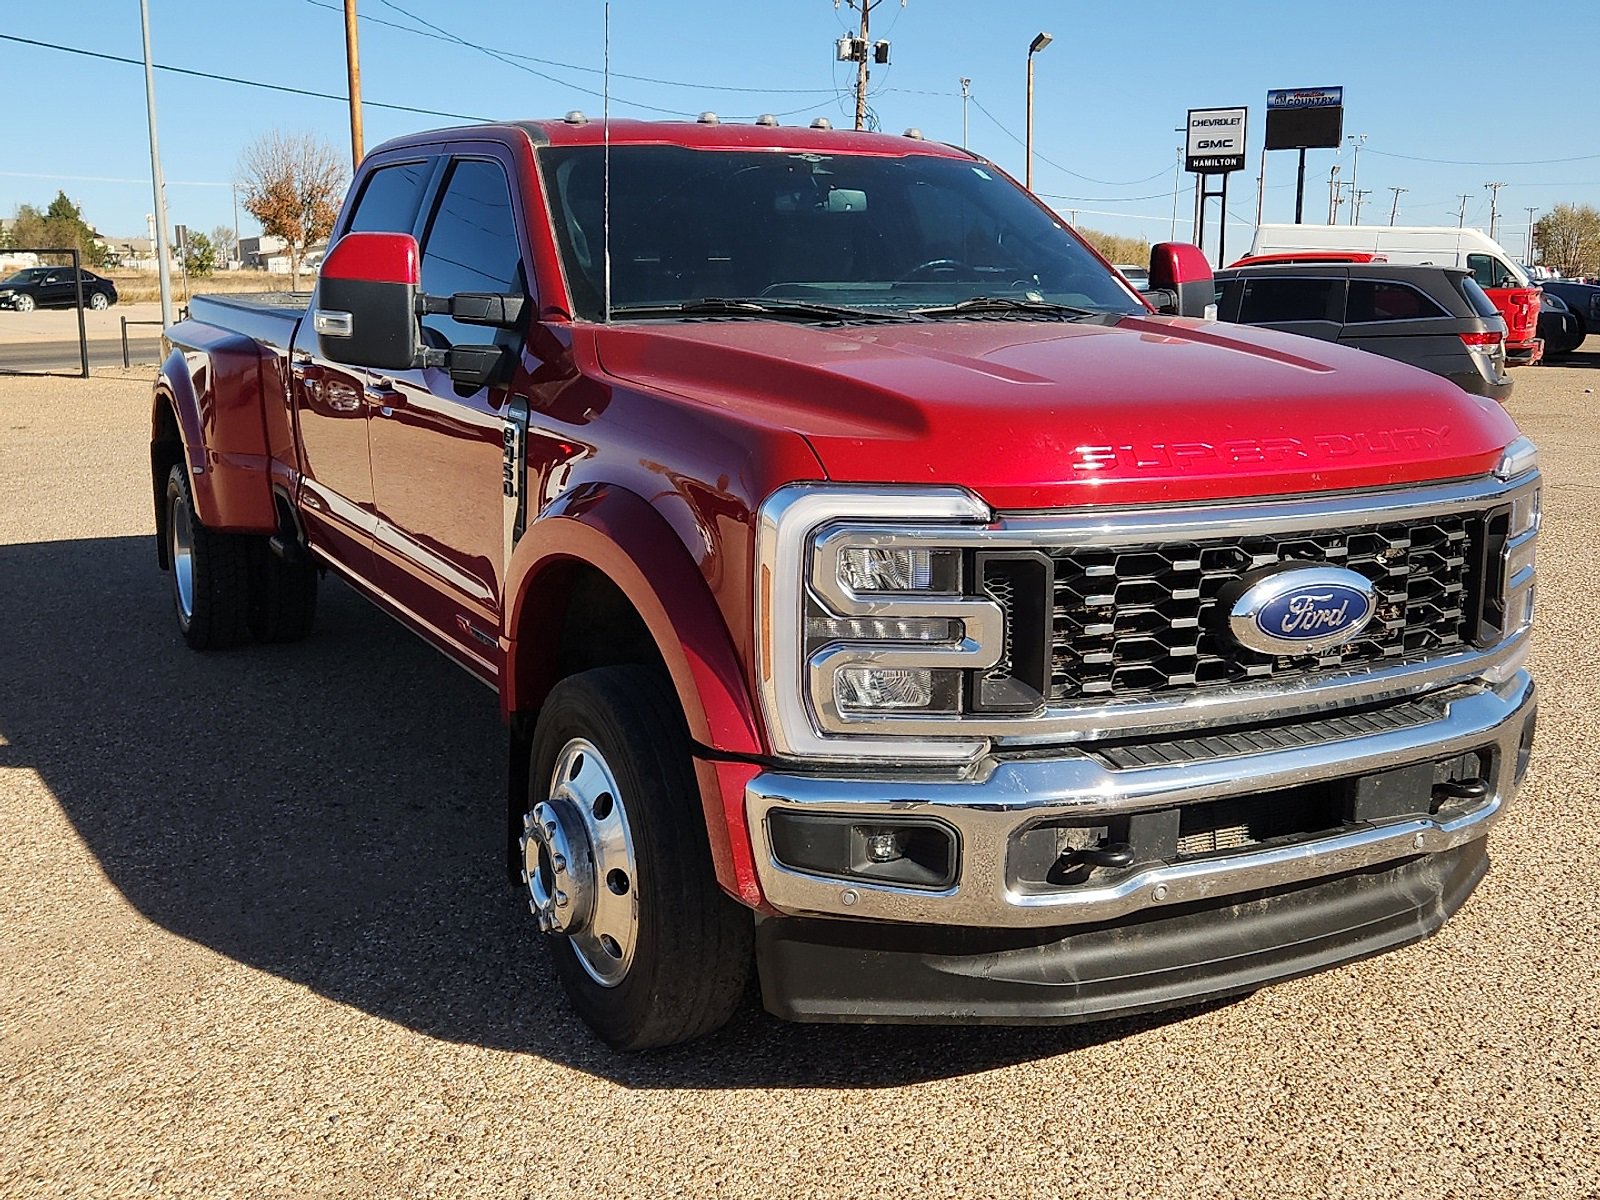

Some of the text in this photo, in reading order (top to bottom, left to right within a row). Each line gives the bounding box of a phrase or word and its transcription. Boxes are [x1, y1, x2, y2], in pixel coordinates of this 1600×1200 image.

[1287, 96, 1335, 106] COUNTRY
[1192, 117, 1241, 127] CHEVROLET
[1197, 139, 1234, 149] GMC
[1193, 157, 1237, 167] HAMILTON
[1072, 425, 1452, 472] SUPER DUTY
[1281, 593, 1349, 633] Ford
